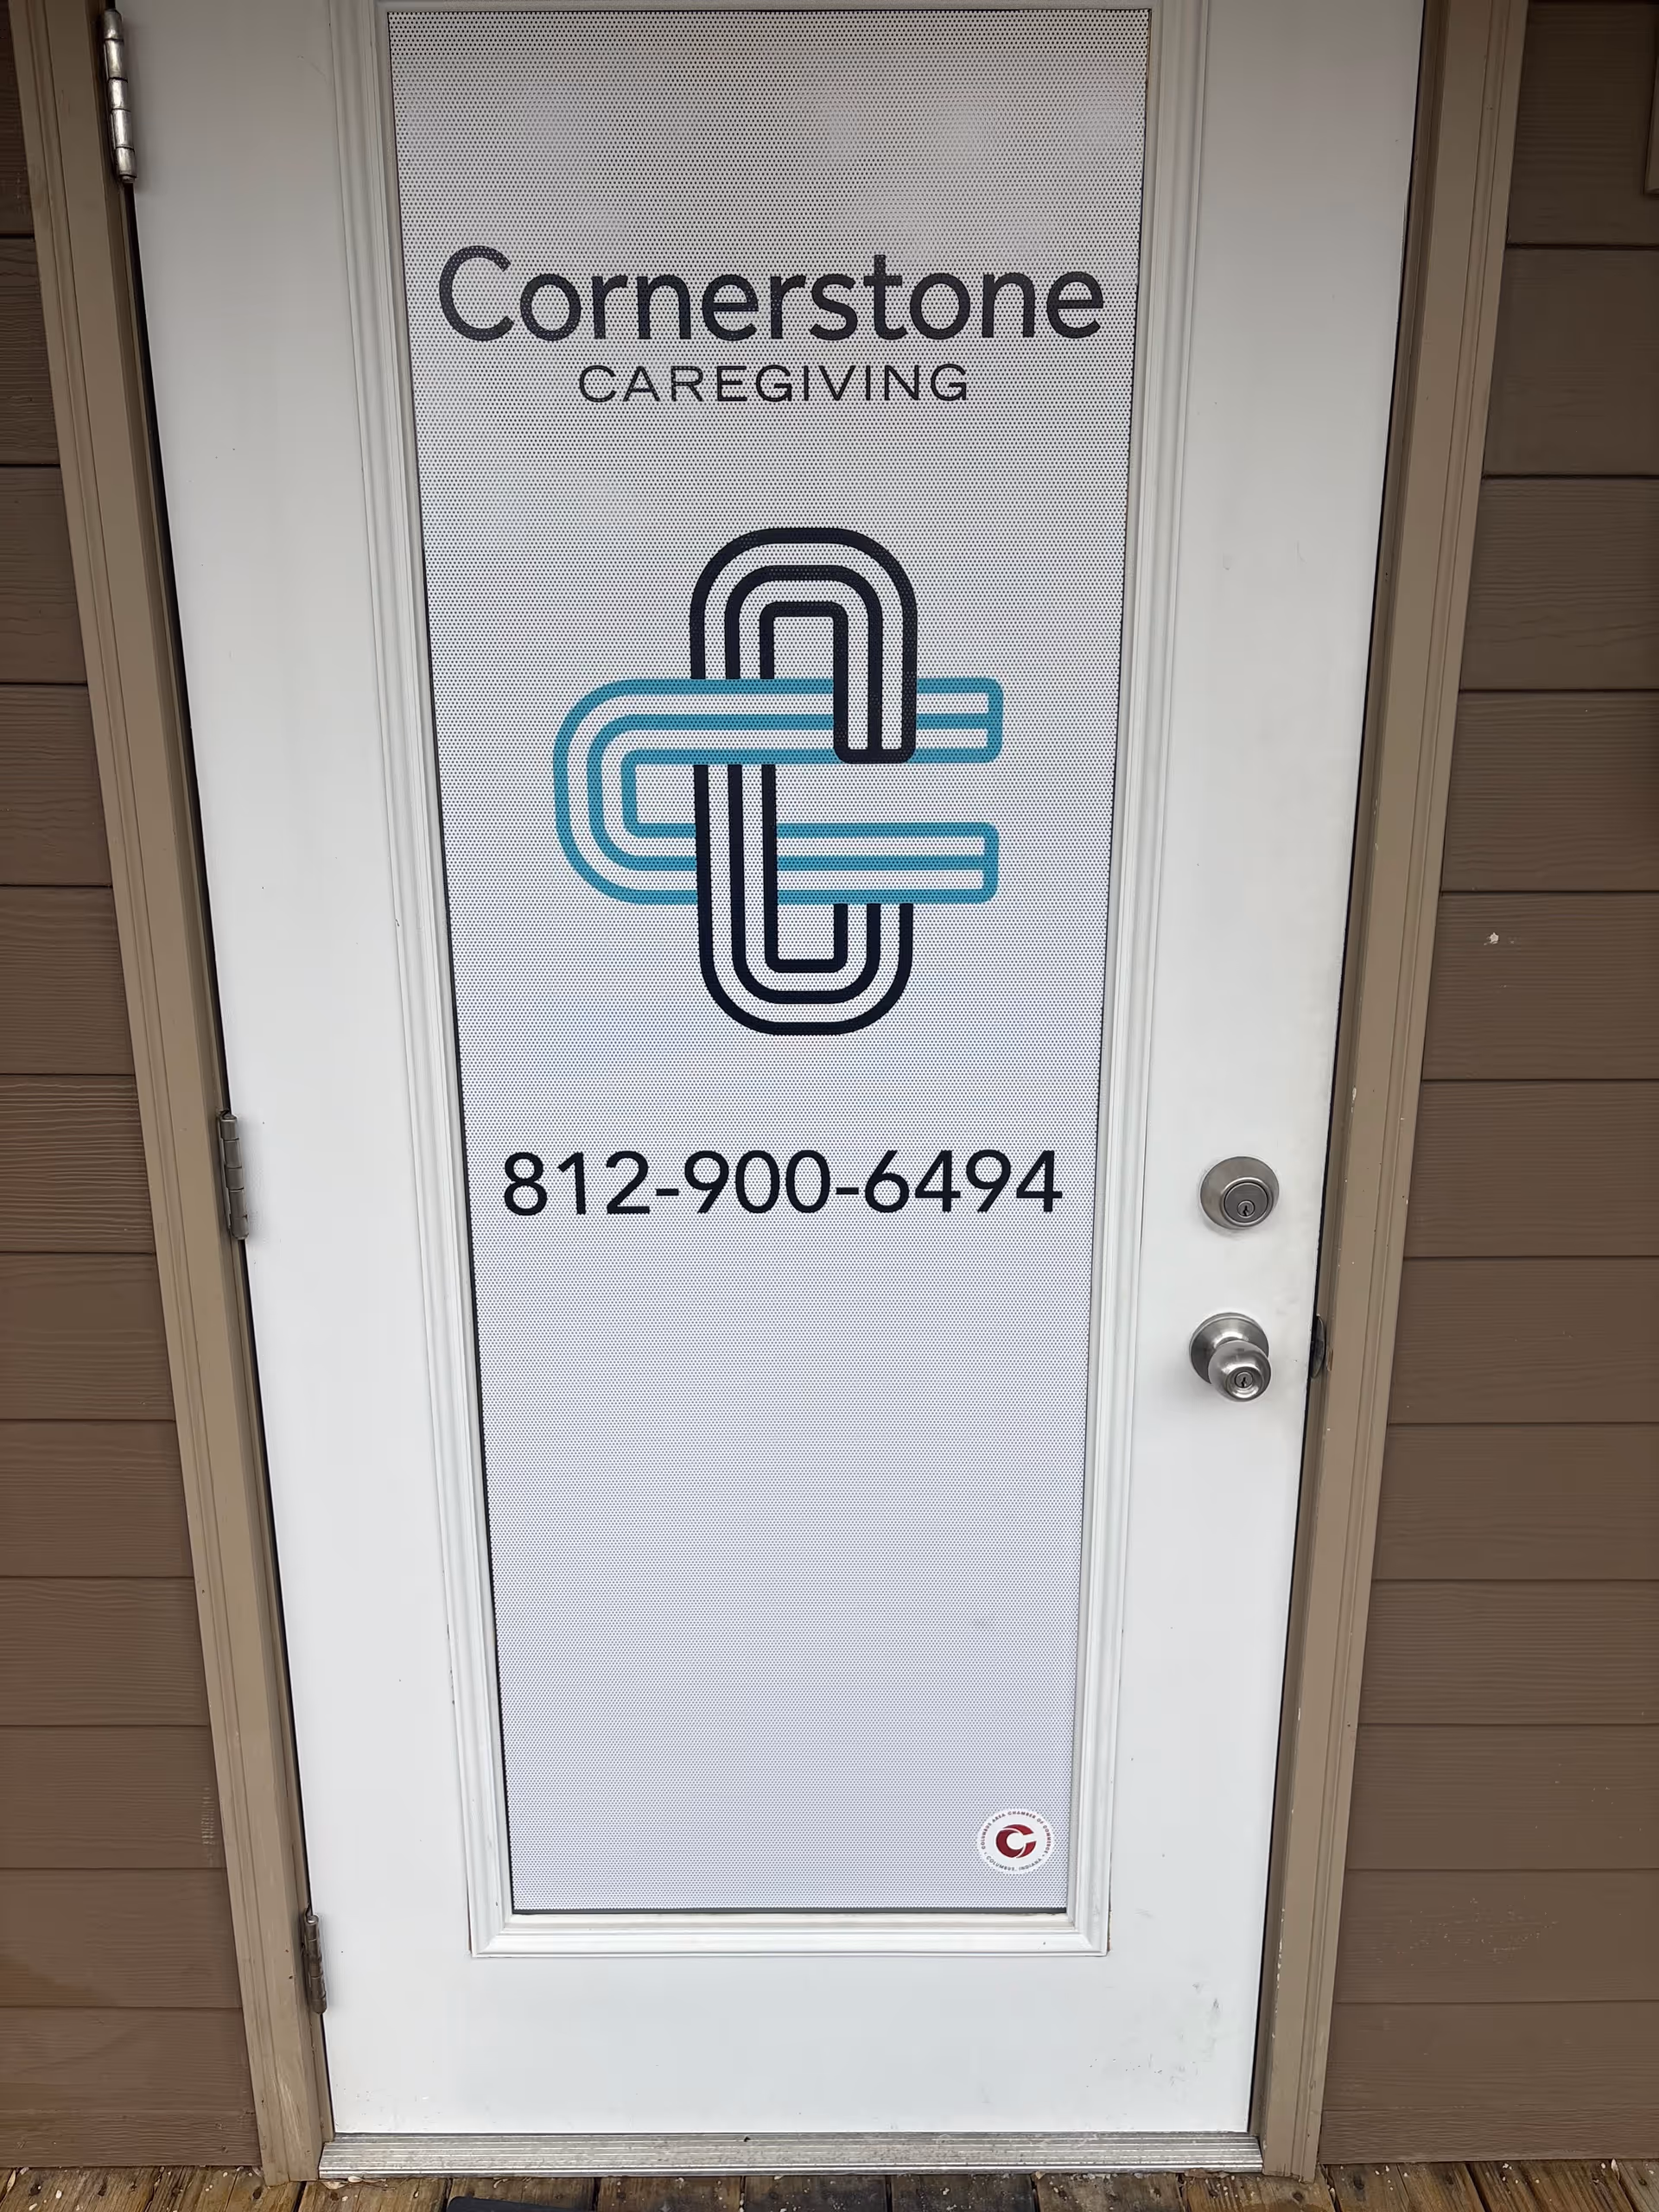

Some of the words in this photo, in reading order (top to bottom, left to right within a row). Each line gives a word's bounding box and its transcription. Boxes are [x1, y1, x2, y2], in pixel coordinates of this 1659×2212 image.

[439, 245, 1103, 340] Cornerstone
[579, 364, 967, 403] CAREGIVING
[505, 1150, 1062, 1216] 812-900-6494
[992, 1813, 1006, 1823] AREA
[1043, 1825, 1052, 1853] COMMERCE
[1019, 1858, 1042, 1871] INDIANA
